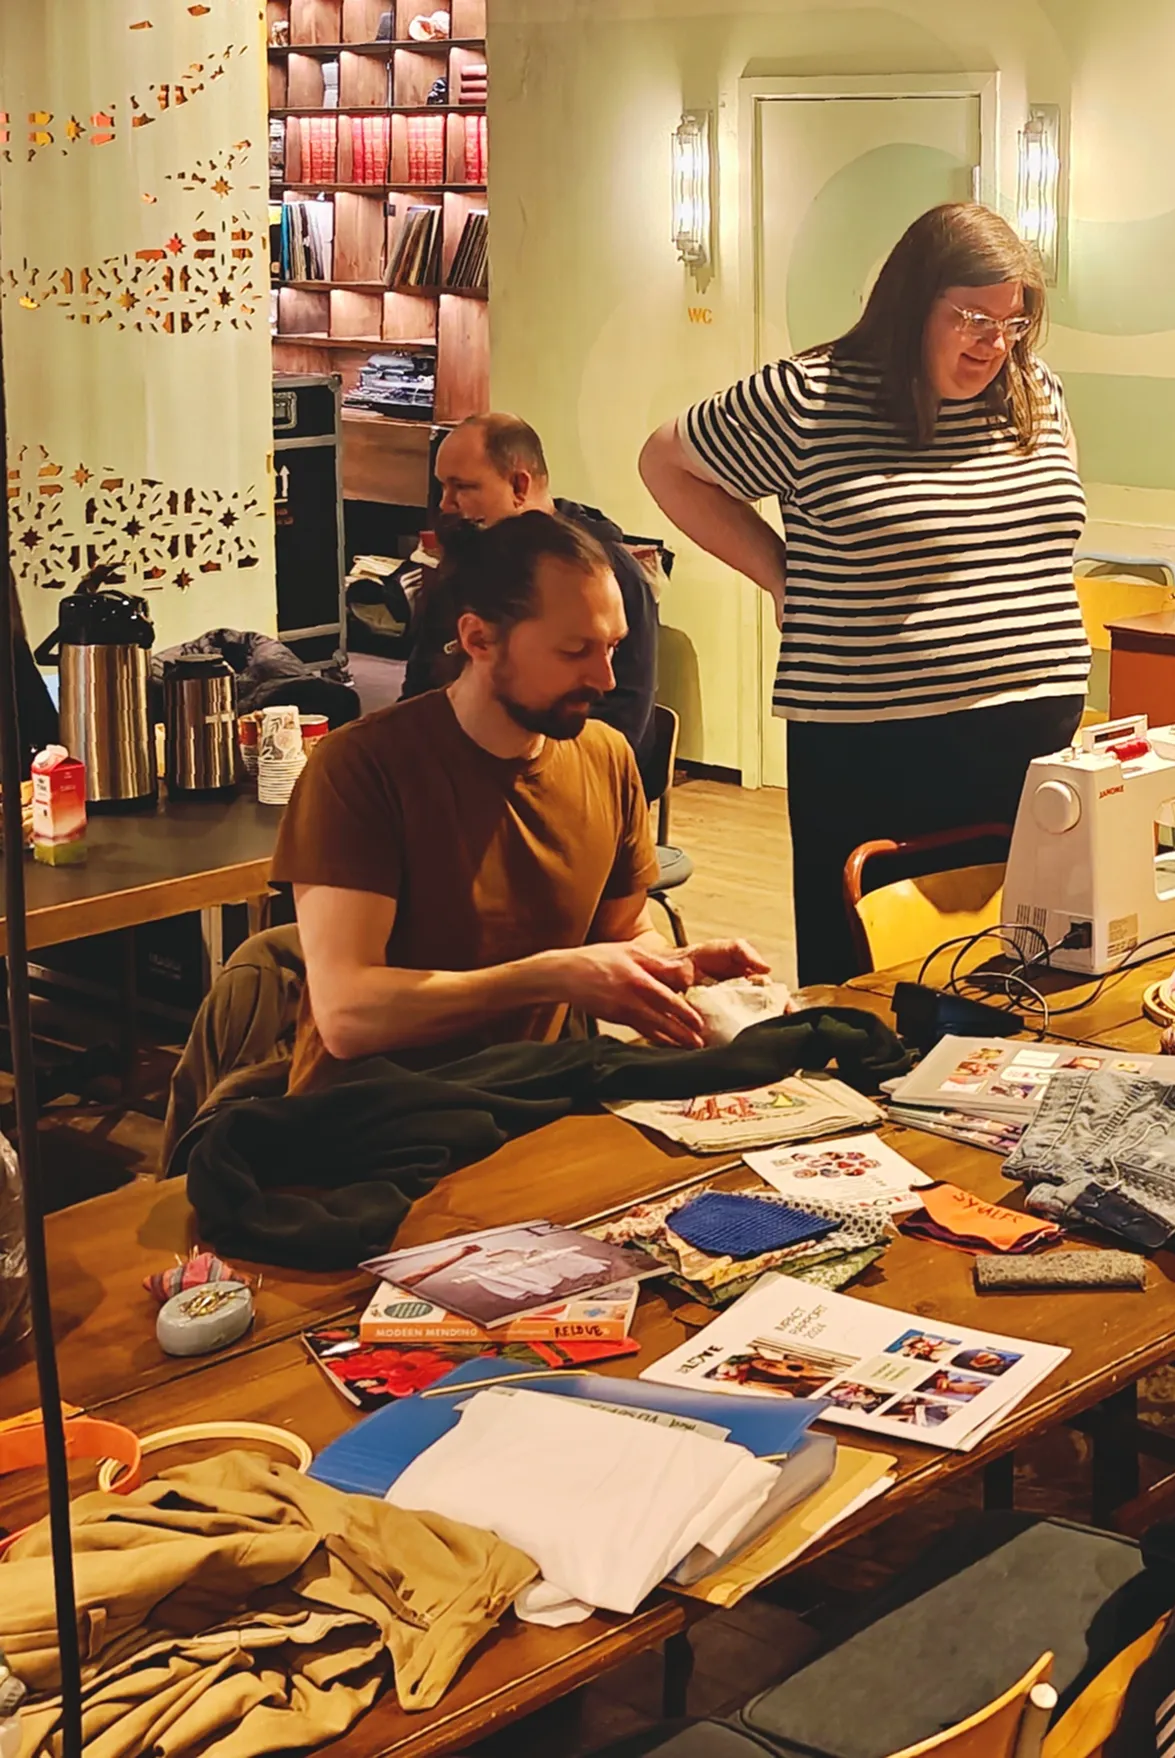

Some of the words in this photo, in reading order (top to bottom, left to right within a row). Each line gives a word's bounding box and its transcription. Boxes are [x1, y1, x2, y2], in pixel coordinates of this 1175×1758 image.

[687, 306, 713, 325] WC
[1098, 784, 1125, 799] JANOME
[376, 1328, 422, 1337] MODERN
[426, 1328, 478, 1337] MENDING
[554, 1324, 603, 1338] RELOVE
